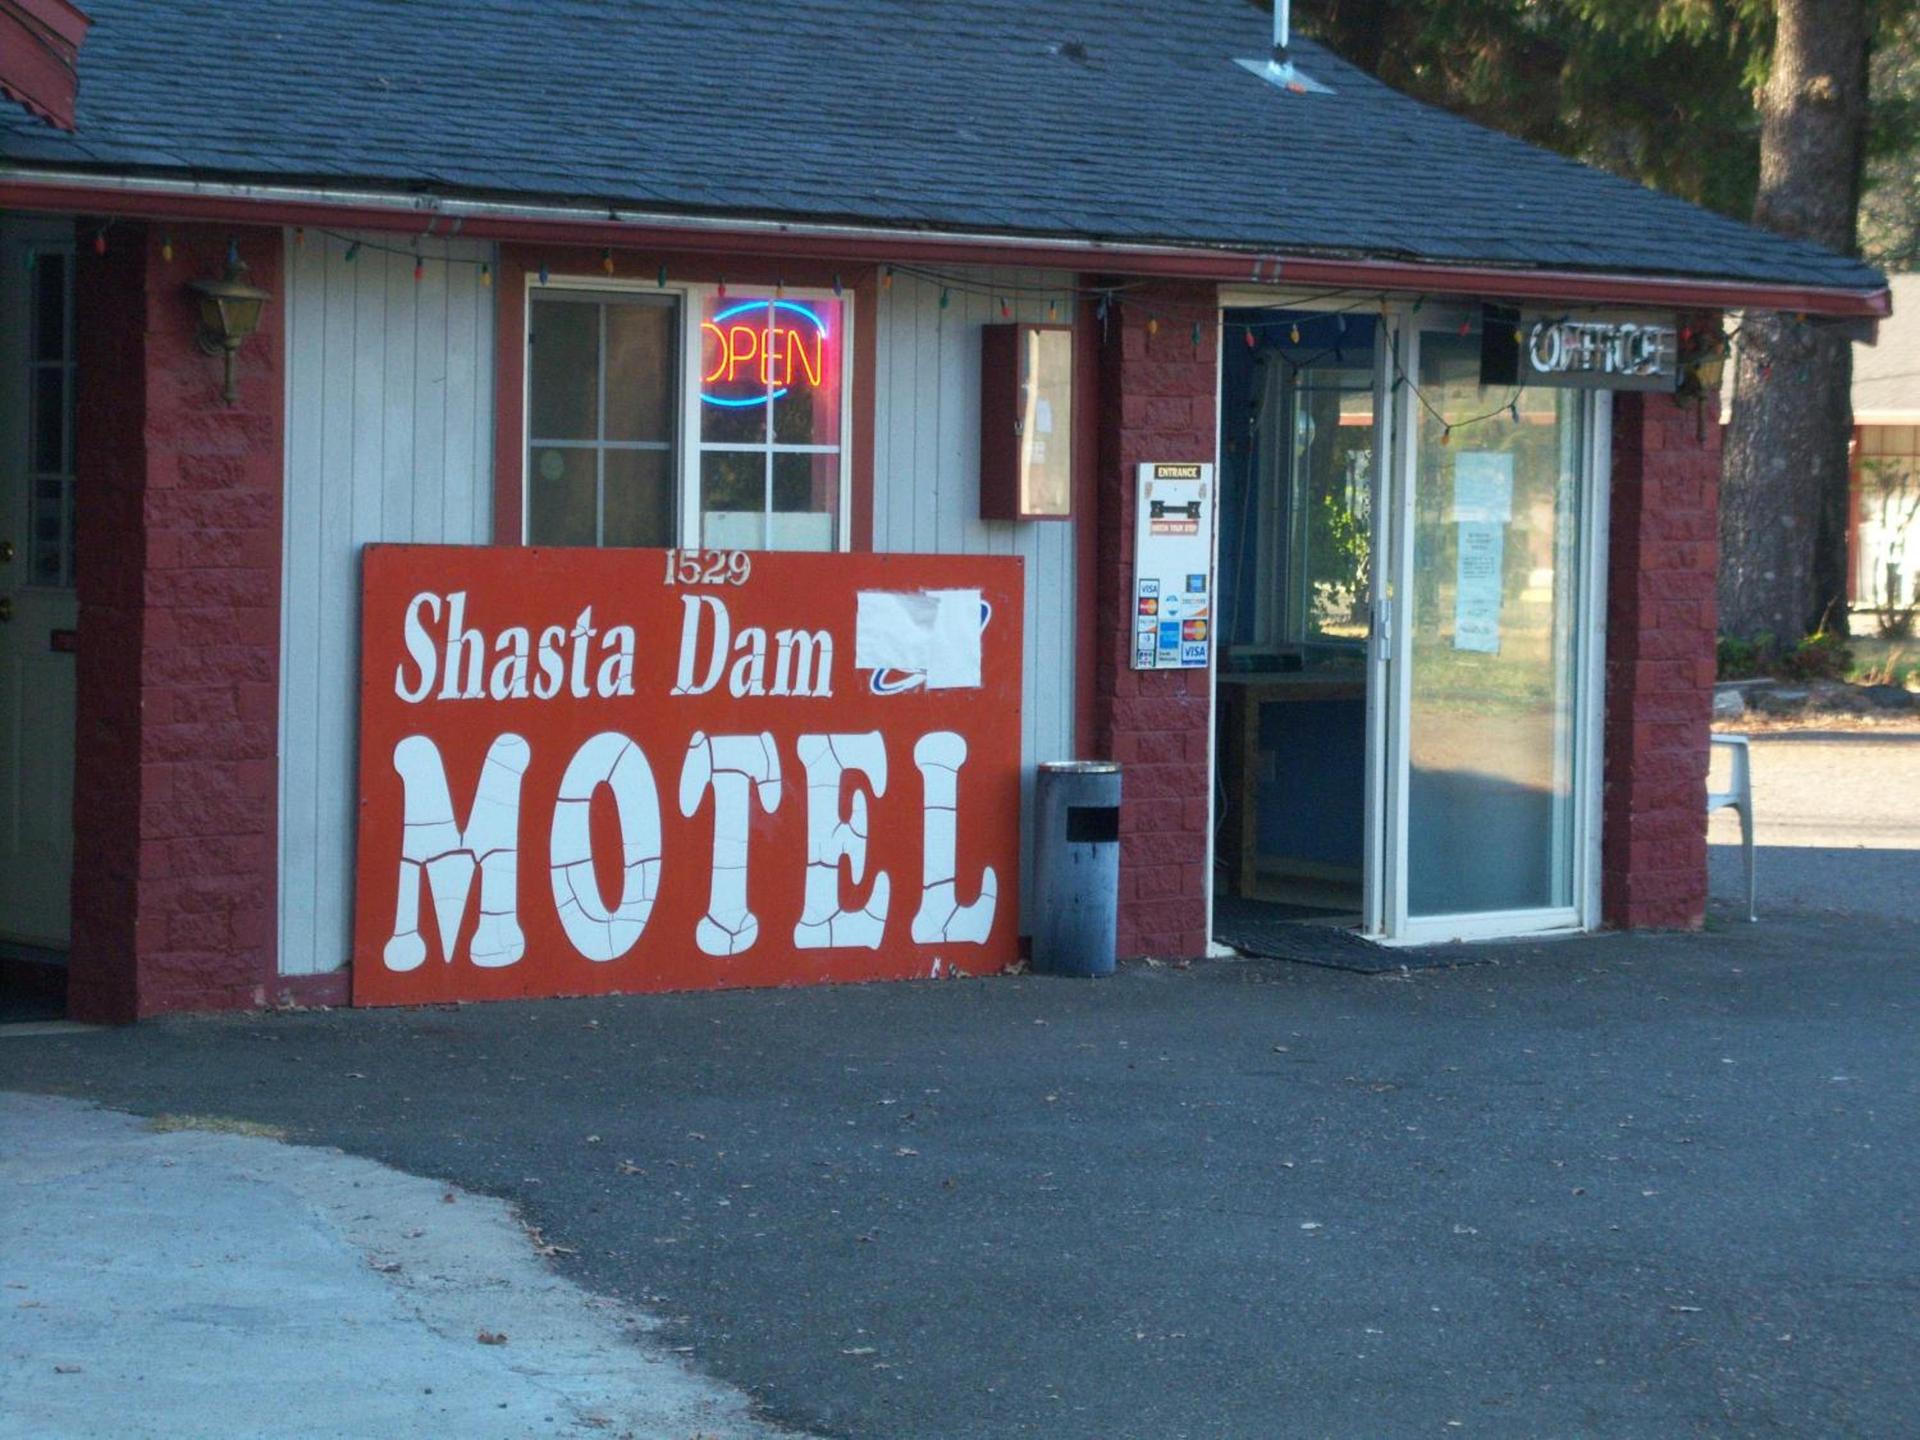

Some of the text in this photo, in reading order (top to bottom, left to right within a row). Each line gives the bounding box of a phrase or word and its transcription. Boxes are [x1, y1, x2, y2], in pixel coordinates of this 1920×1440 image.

[700, 321, 823, 387] OPEN
[1529, 321, 1675, 376] OFFICE
[1157, 466, 1198, 478] ENTRANCE
[664, 548, 751, 586] 1529
[1141, 585, 1158, 593] VISA
[394, 590, 834, 704] Shasta Dam
[1184, 646, 1206, 657] VISA
[383, 730, 998, 972] MOTEL
